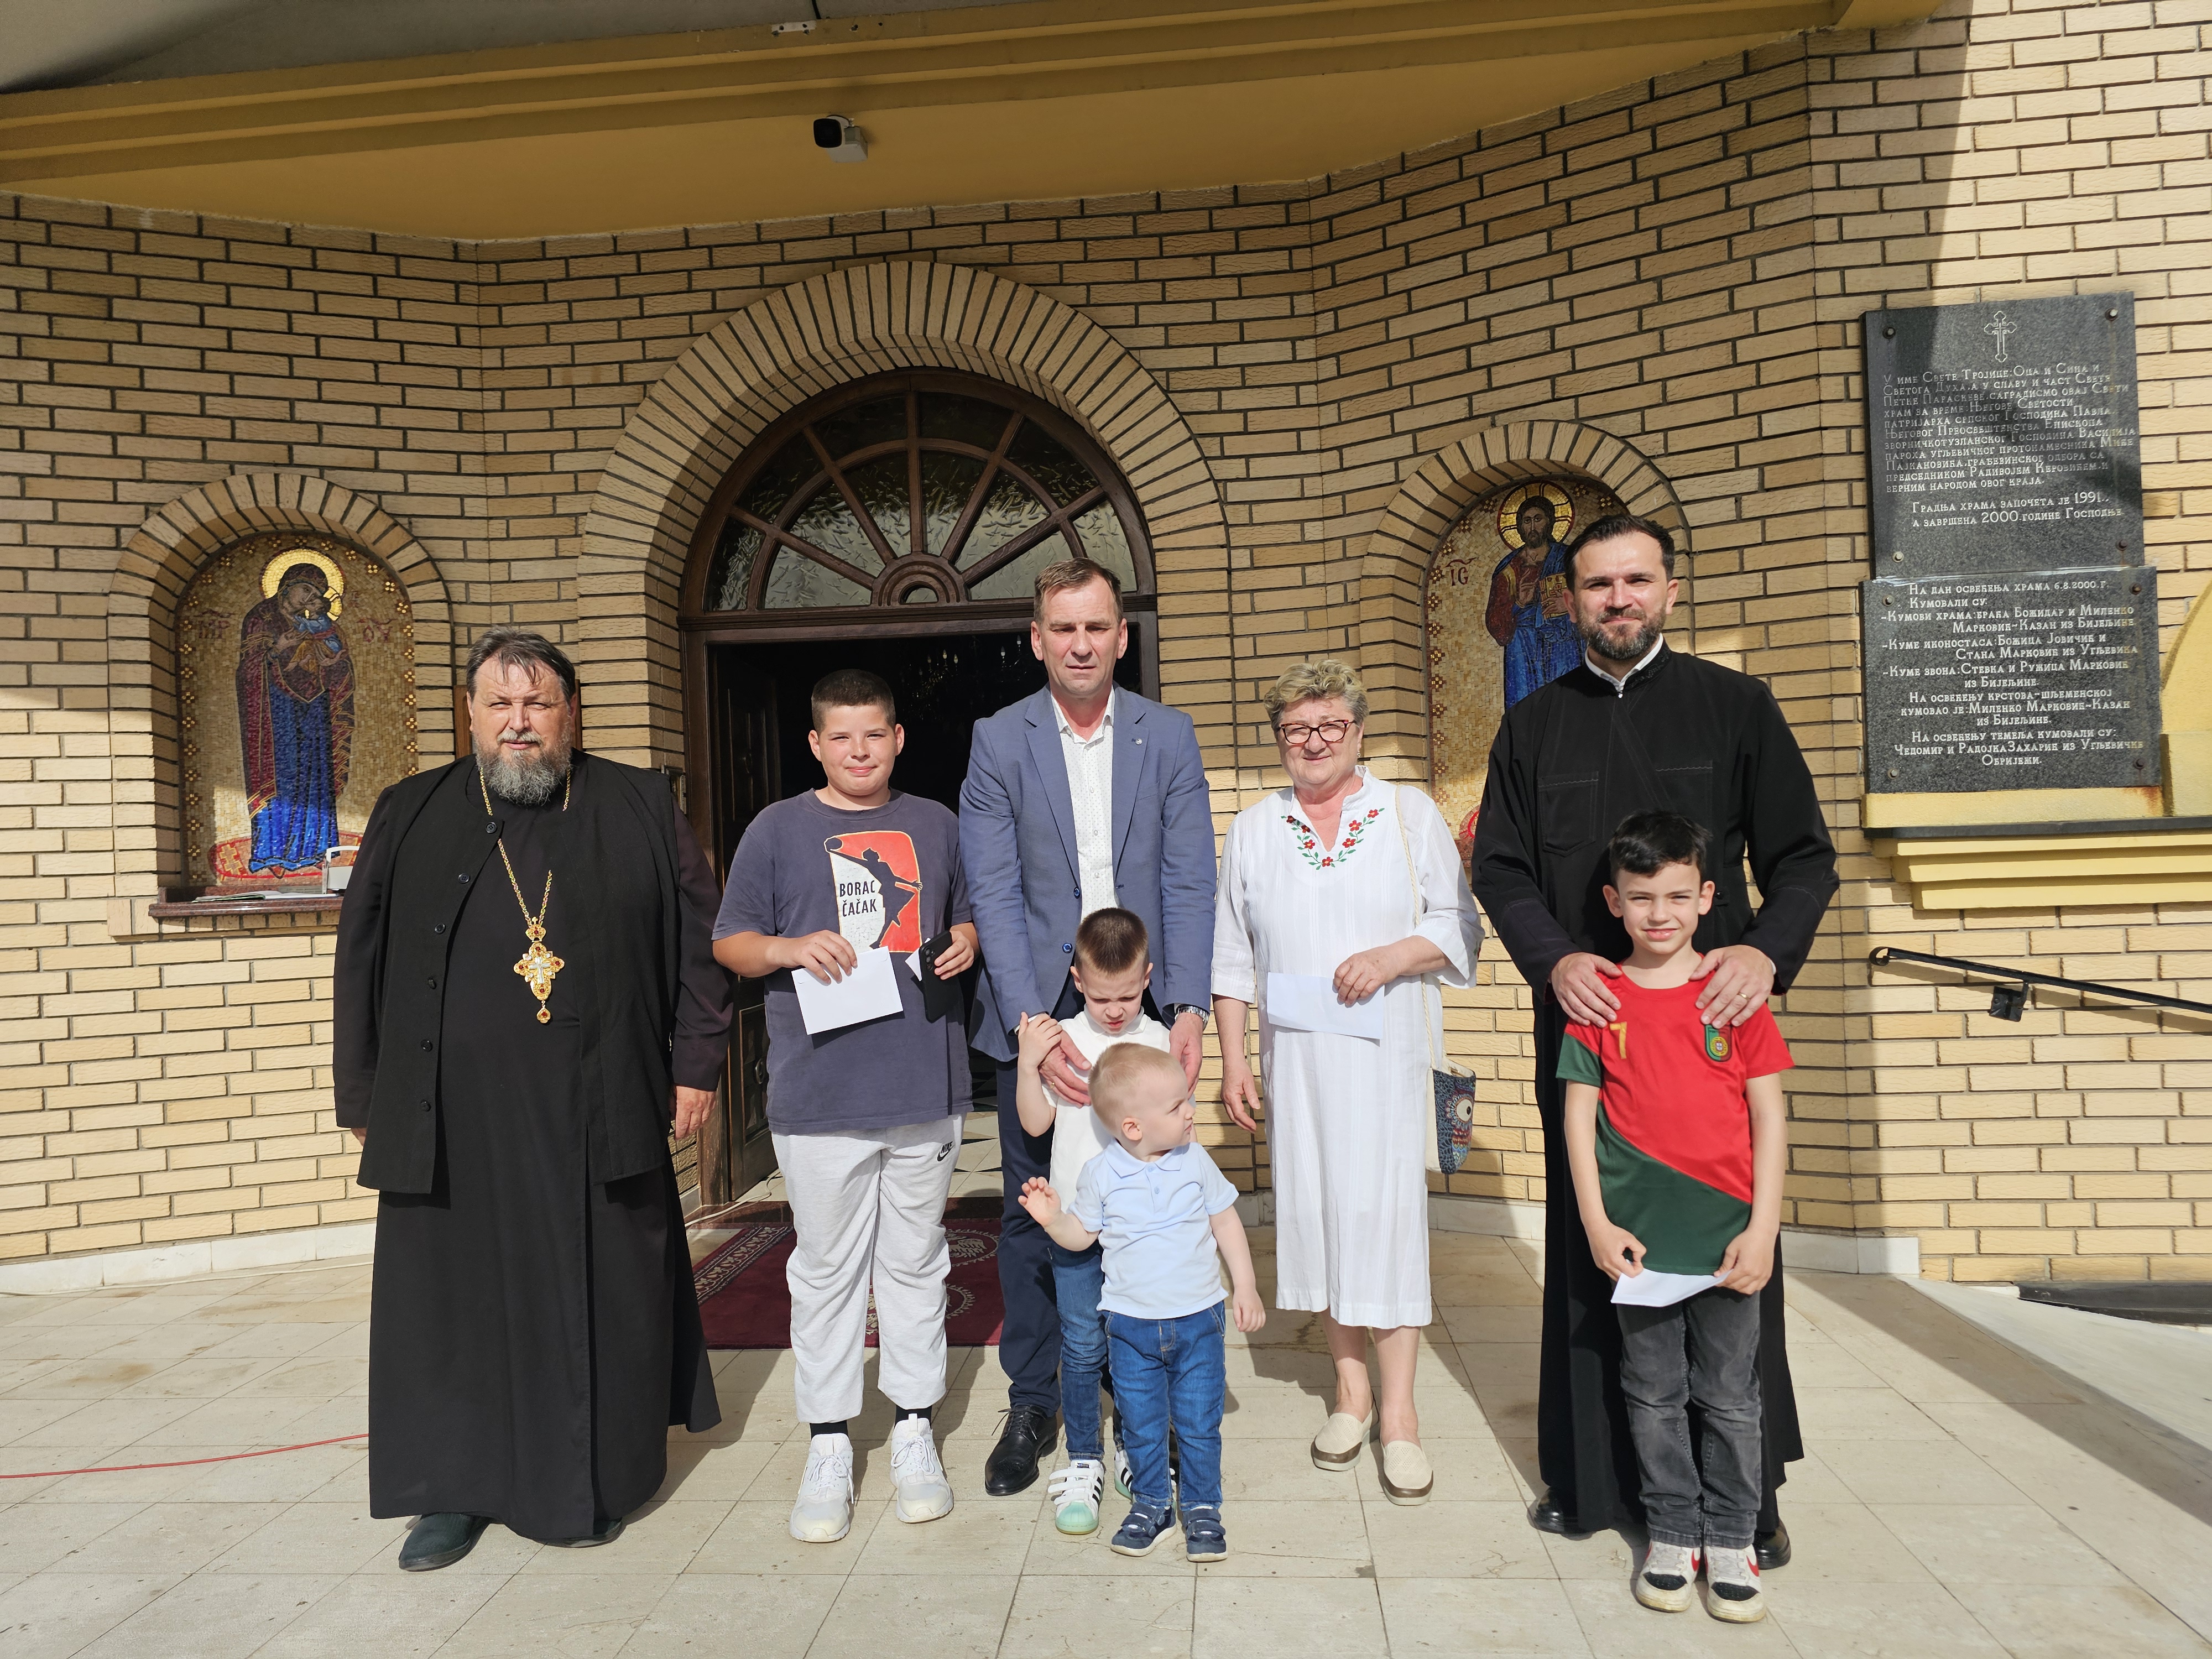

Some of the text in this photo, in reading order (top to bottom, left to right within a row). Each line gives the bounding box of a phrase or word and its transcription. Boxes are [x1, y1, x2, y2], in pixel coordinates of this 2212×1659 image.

[839, 880, 875, 898] BORAC
[842, 898, 878, 917] ČAČAK
[1610, 1021, 1627, 1059] 7
[940, 1141, 953, 1154] NIKE
